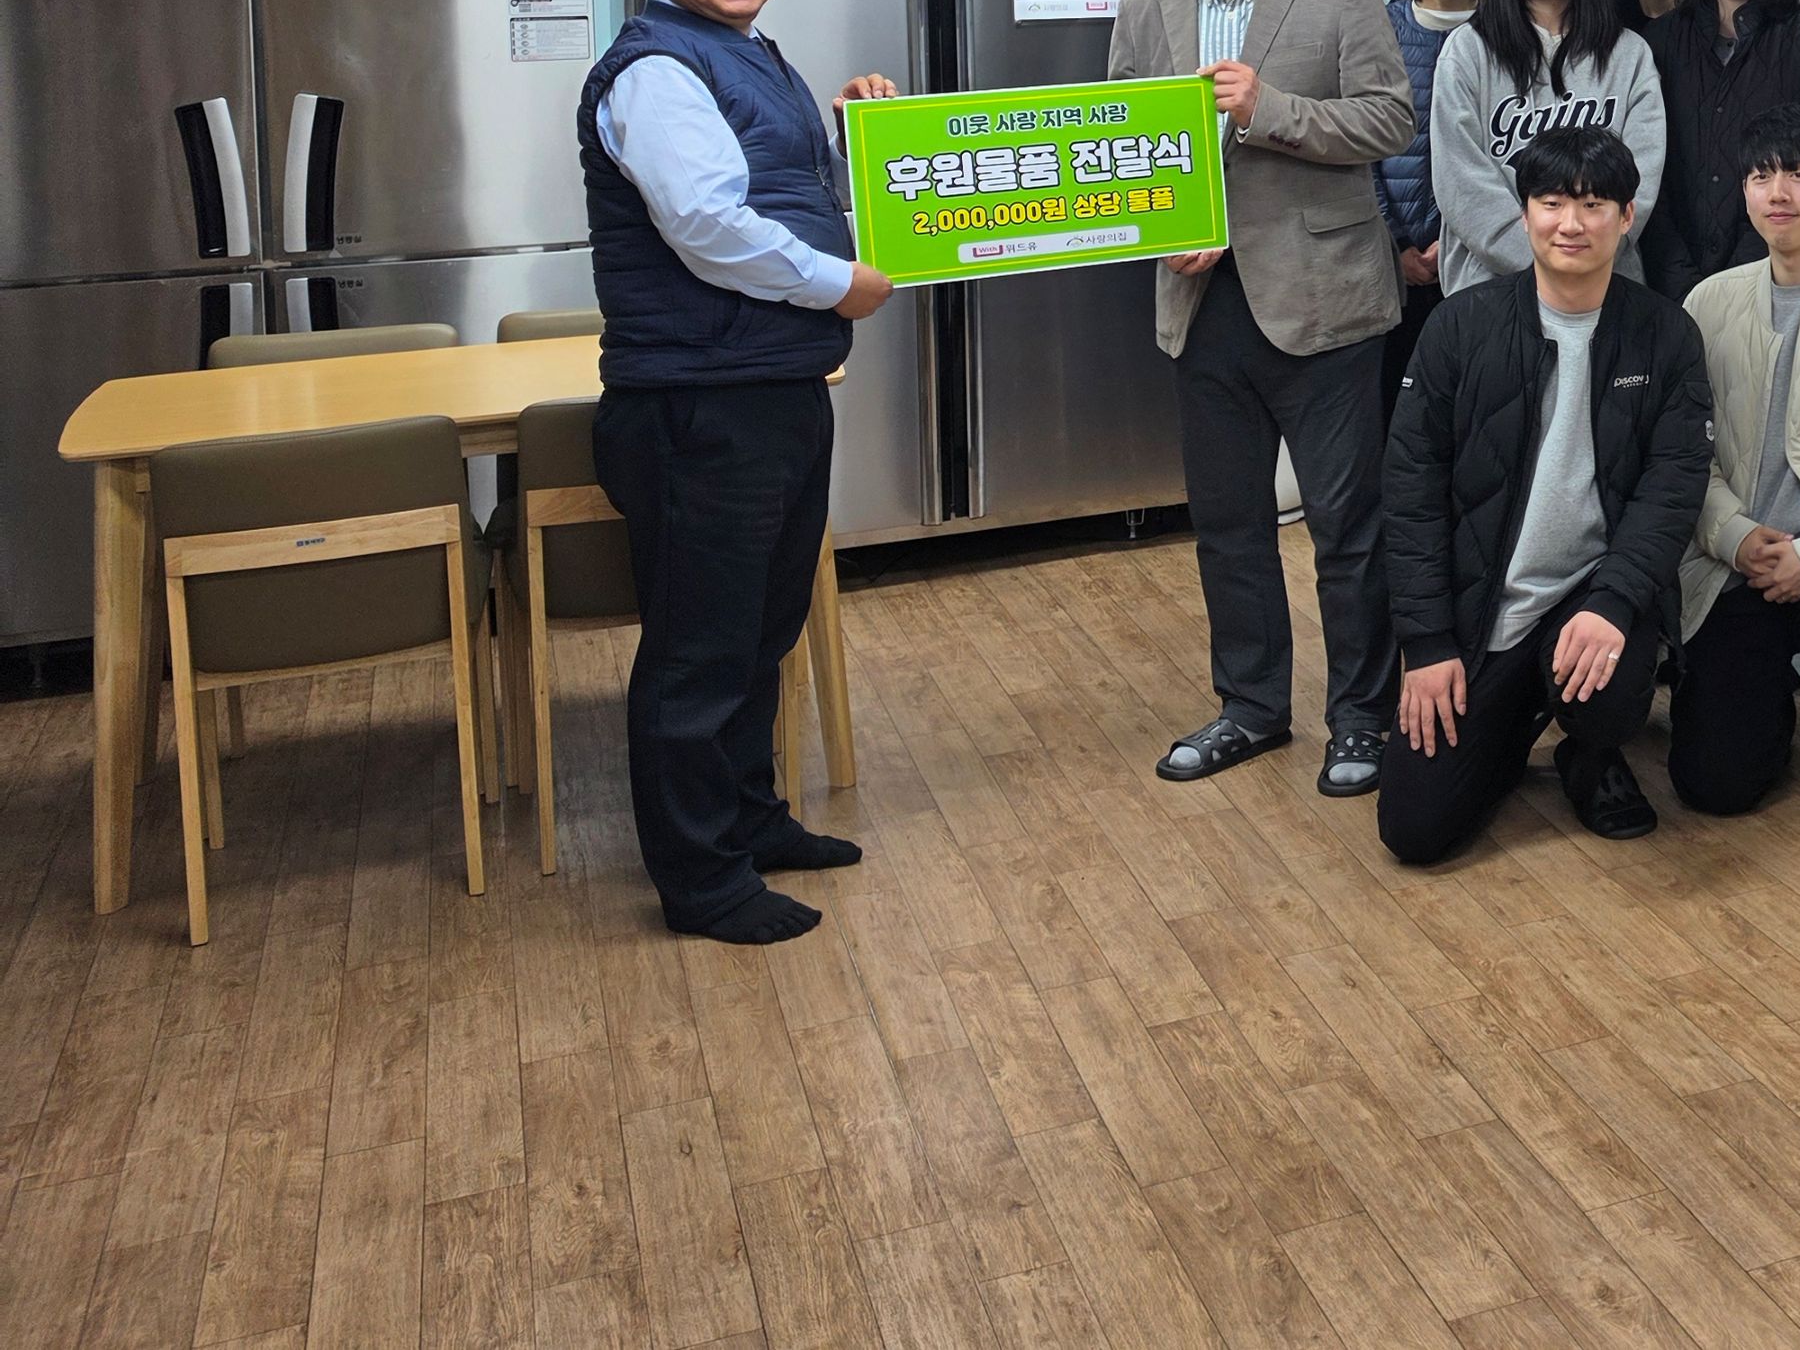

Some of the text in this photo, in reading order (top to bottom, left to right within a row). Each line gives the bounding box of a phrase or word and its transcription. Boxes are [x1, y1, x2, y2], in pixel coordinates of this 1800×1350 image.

[949, 103, 1128, 136] 이웃 사랑 지역 사랑
[886, 131, 1193, 201] 후원물품 전달식
[912, 185, 1175, 237] 2,000,000원 상당 물품
